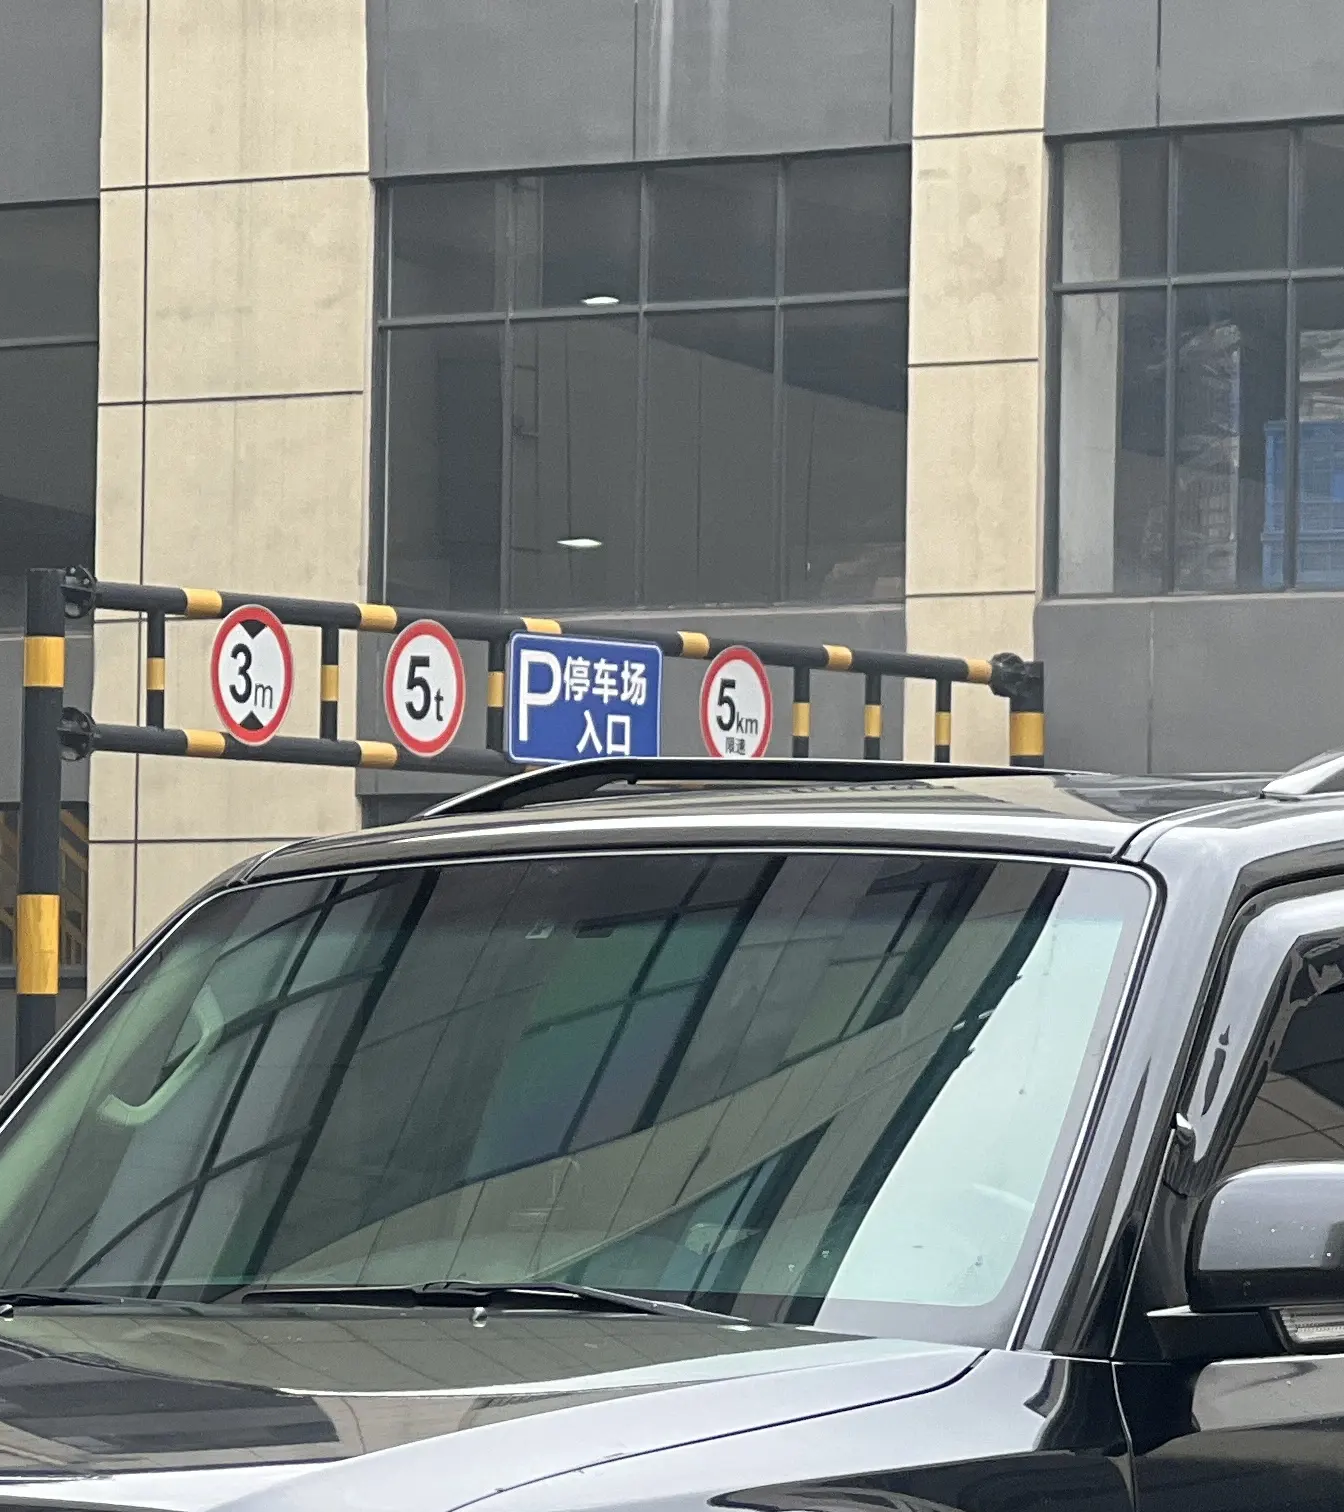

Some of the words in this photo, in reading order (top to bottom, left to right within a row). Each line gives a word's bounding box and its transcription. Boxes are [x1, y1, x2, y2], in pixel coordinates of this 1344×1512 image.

[229, 643, 274, 709] 3m
[405, 655, 444, 721] 5t
[518, 648, 562, 742] P
[564, 655, 648, 706] 停车场
[716, 678, 759, 735] 5km
[576, 709, 632, 756] 入口
